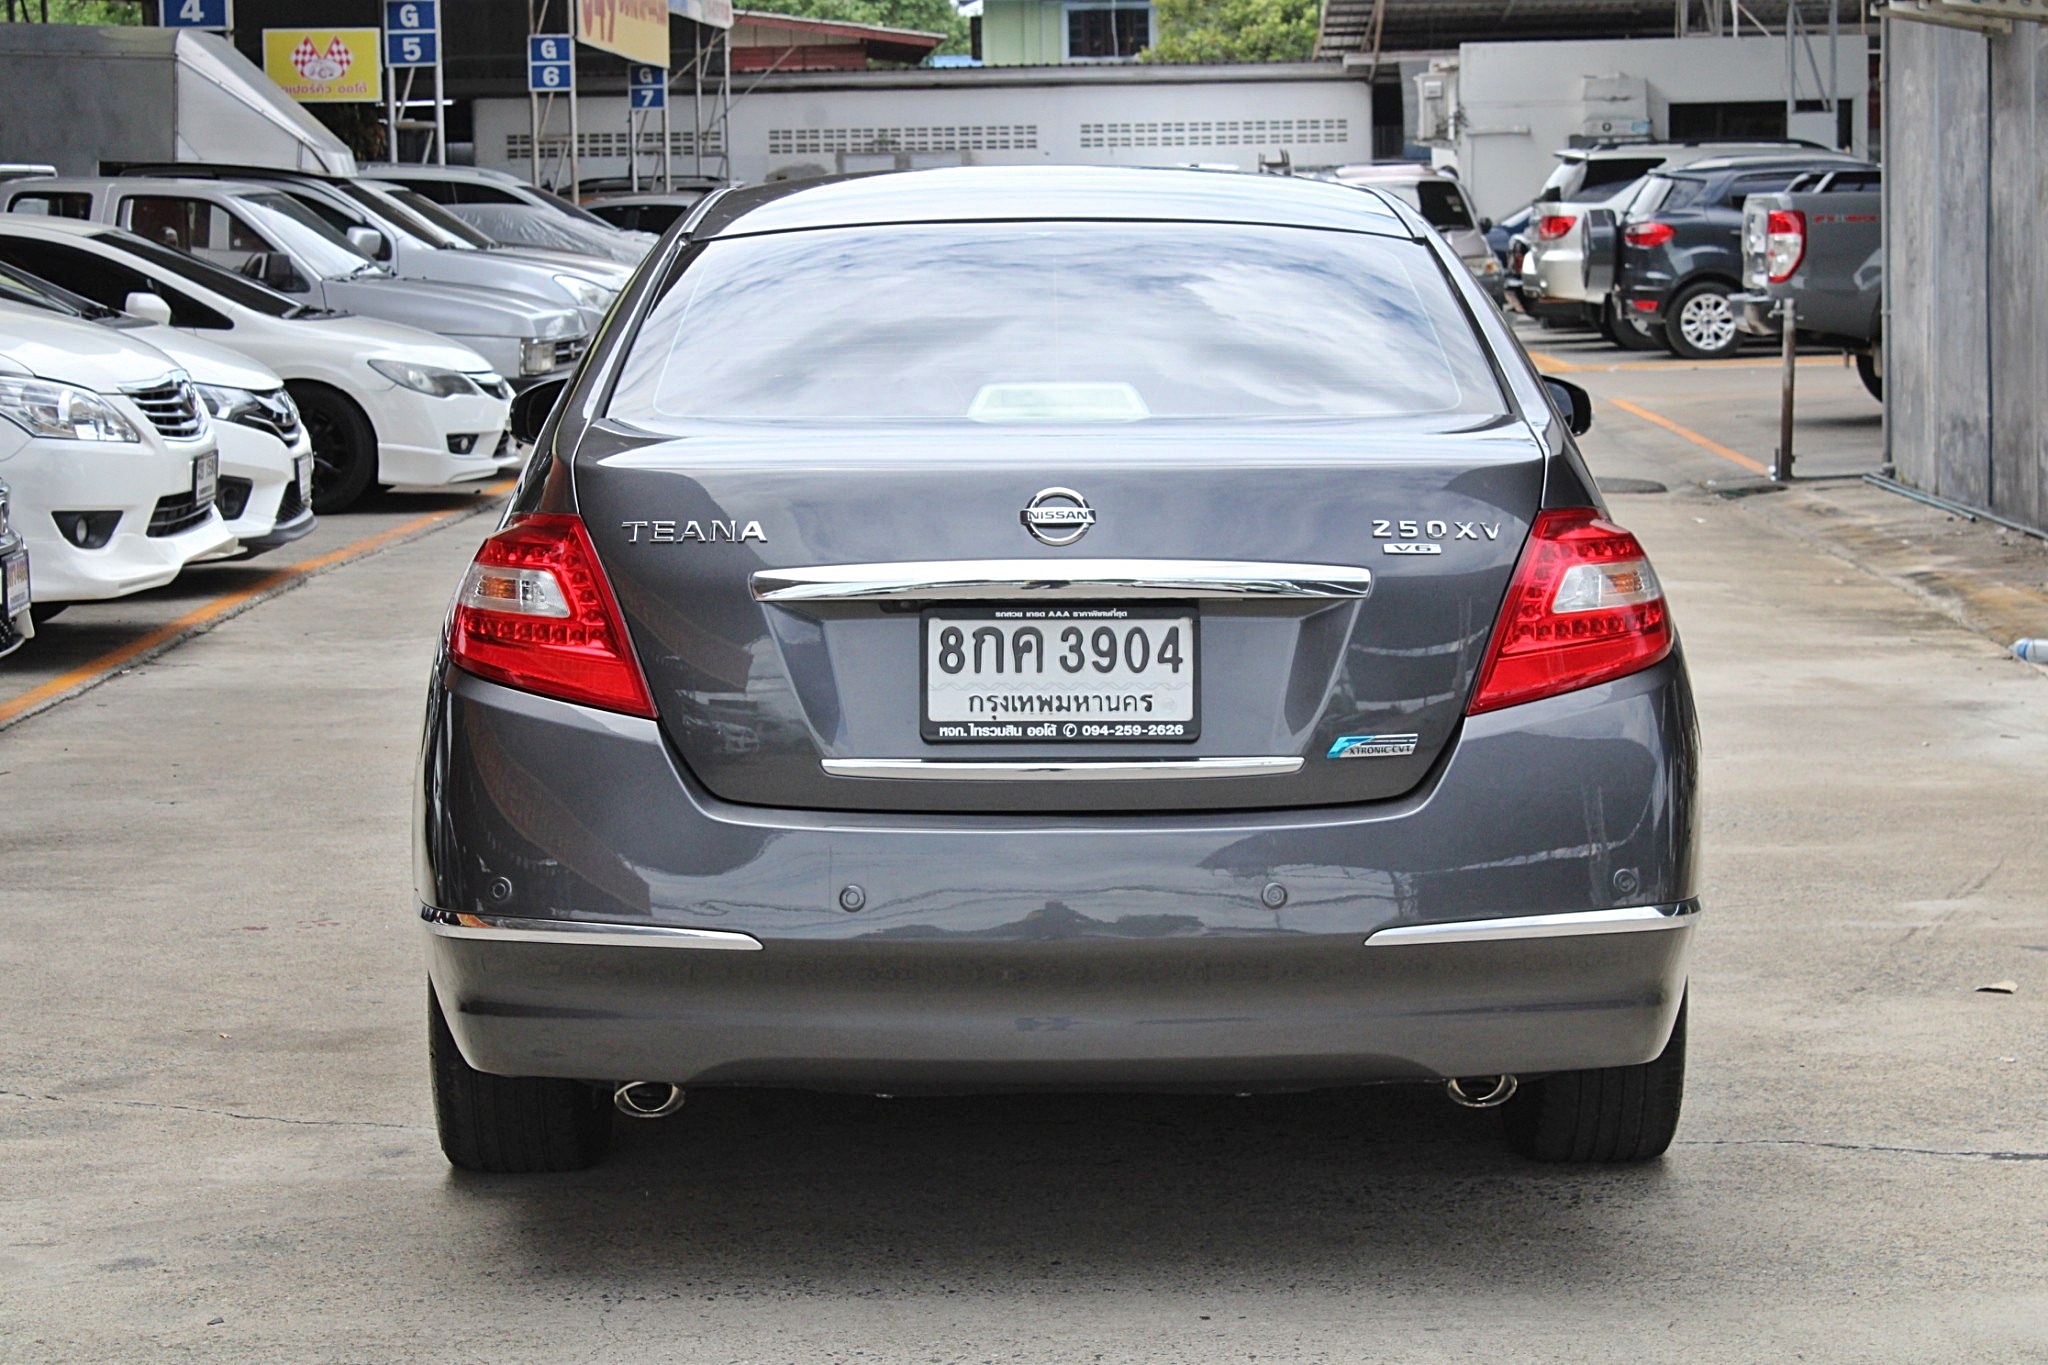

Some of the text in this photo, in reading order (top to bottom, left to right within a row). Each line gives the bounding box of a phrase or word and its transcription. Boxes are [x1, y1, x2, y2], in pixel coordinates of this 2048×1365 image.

[179, 0, 205, 22] 4
[399, 3, 419, 28] G
[402, 37, 422, 61] 5
[541, 39, 557, 59] G
[543, 66, 560, 86] 6
[639, 67, 653, 84] G
[641, 90, 654, 107] 7
[1028, 510, 1088, 520] NISSAN
[621, 519, 769, 543] TEANA
[1392, 544, 1433, 552] V6
[938, 625, 1184, 674] 8กค 3904
[968, 692, 1154, 720] กรุงเทพมหานคร
[939, 726, 967, 737] หจก.
[1027, 723, 1057, 737] ออโต้
[1082, 724, 1184, 737] 094-259-2626
[1349, 745, 1411, 755] XTRONIC CVT
